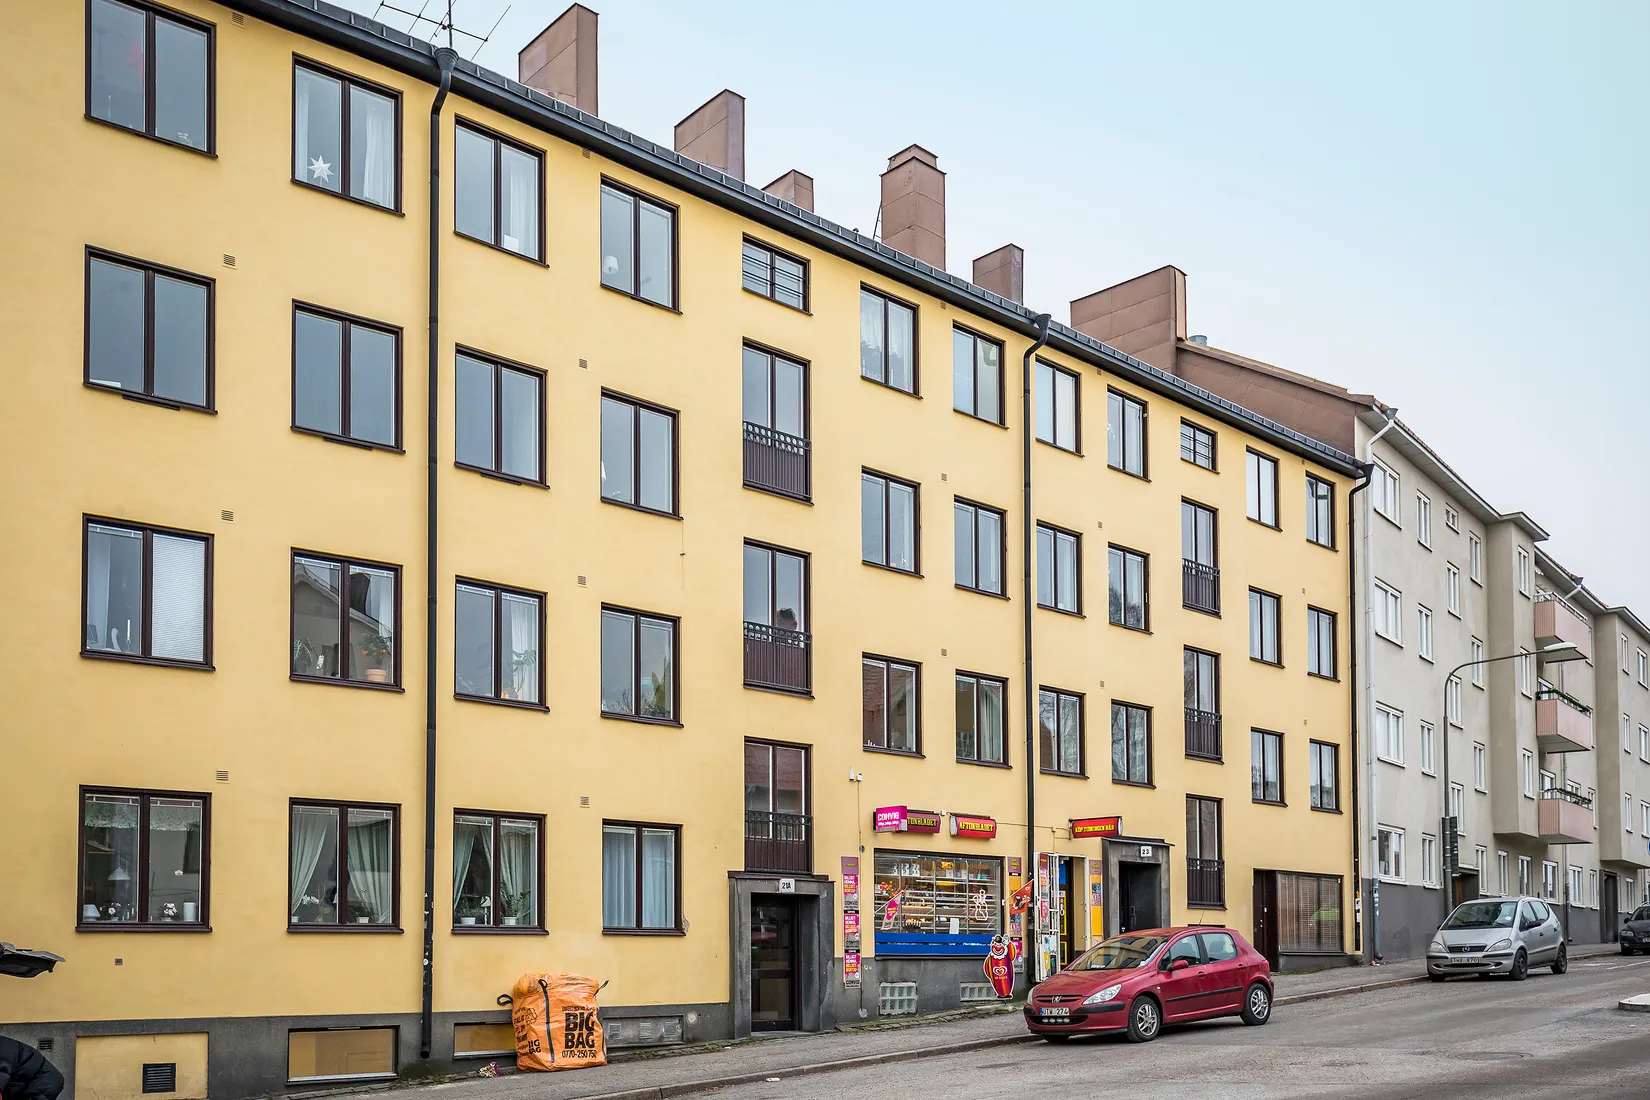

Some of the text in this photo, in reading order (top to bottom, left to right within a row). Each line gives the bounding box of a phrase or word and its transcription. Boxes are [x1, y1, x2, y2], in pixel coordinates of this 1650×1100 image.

[907, 816, 937, 827] TONBLADET
[960, 822, 994, 832] AFTONBLADET
[565, 1012, 594, 1032] BIG
[564, 1032, 594, 1049] BAG
